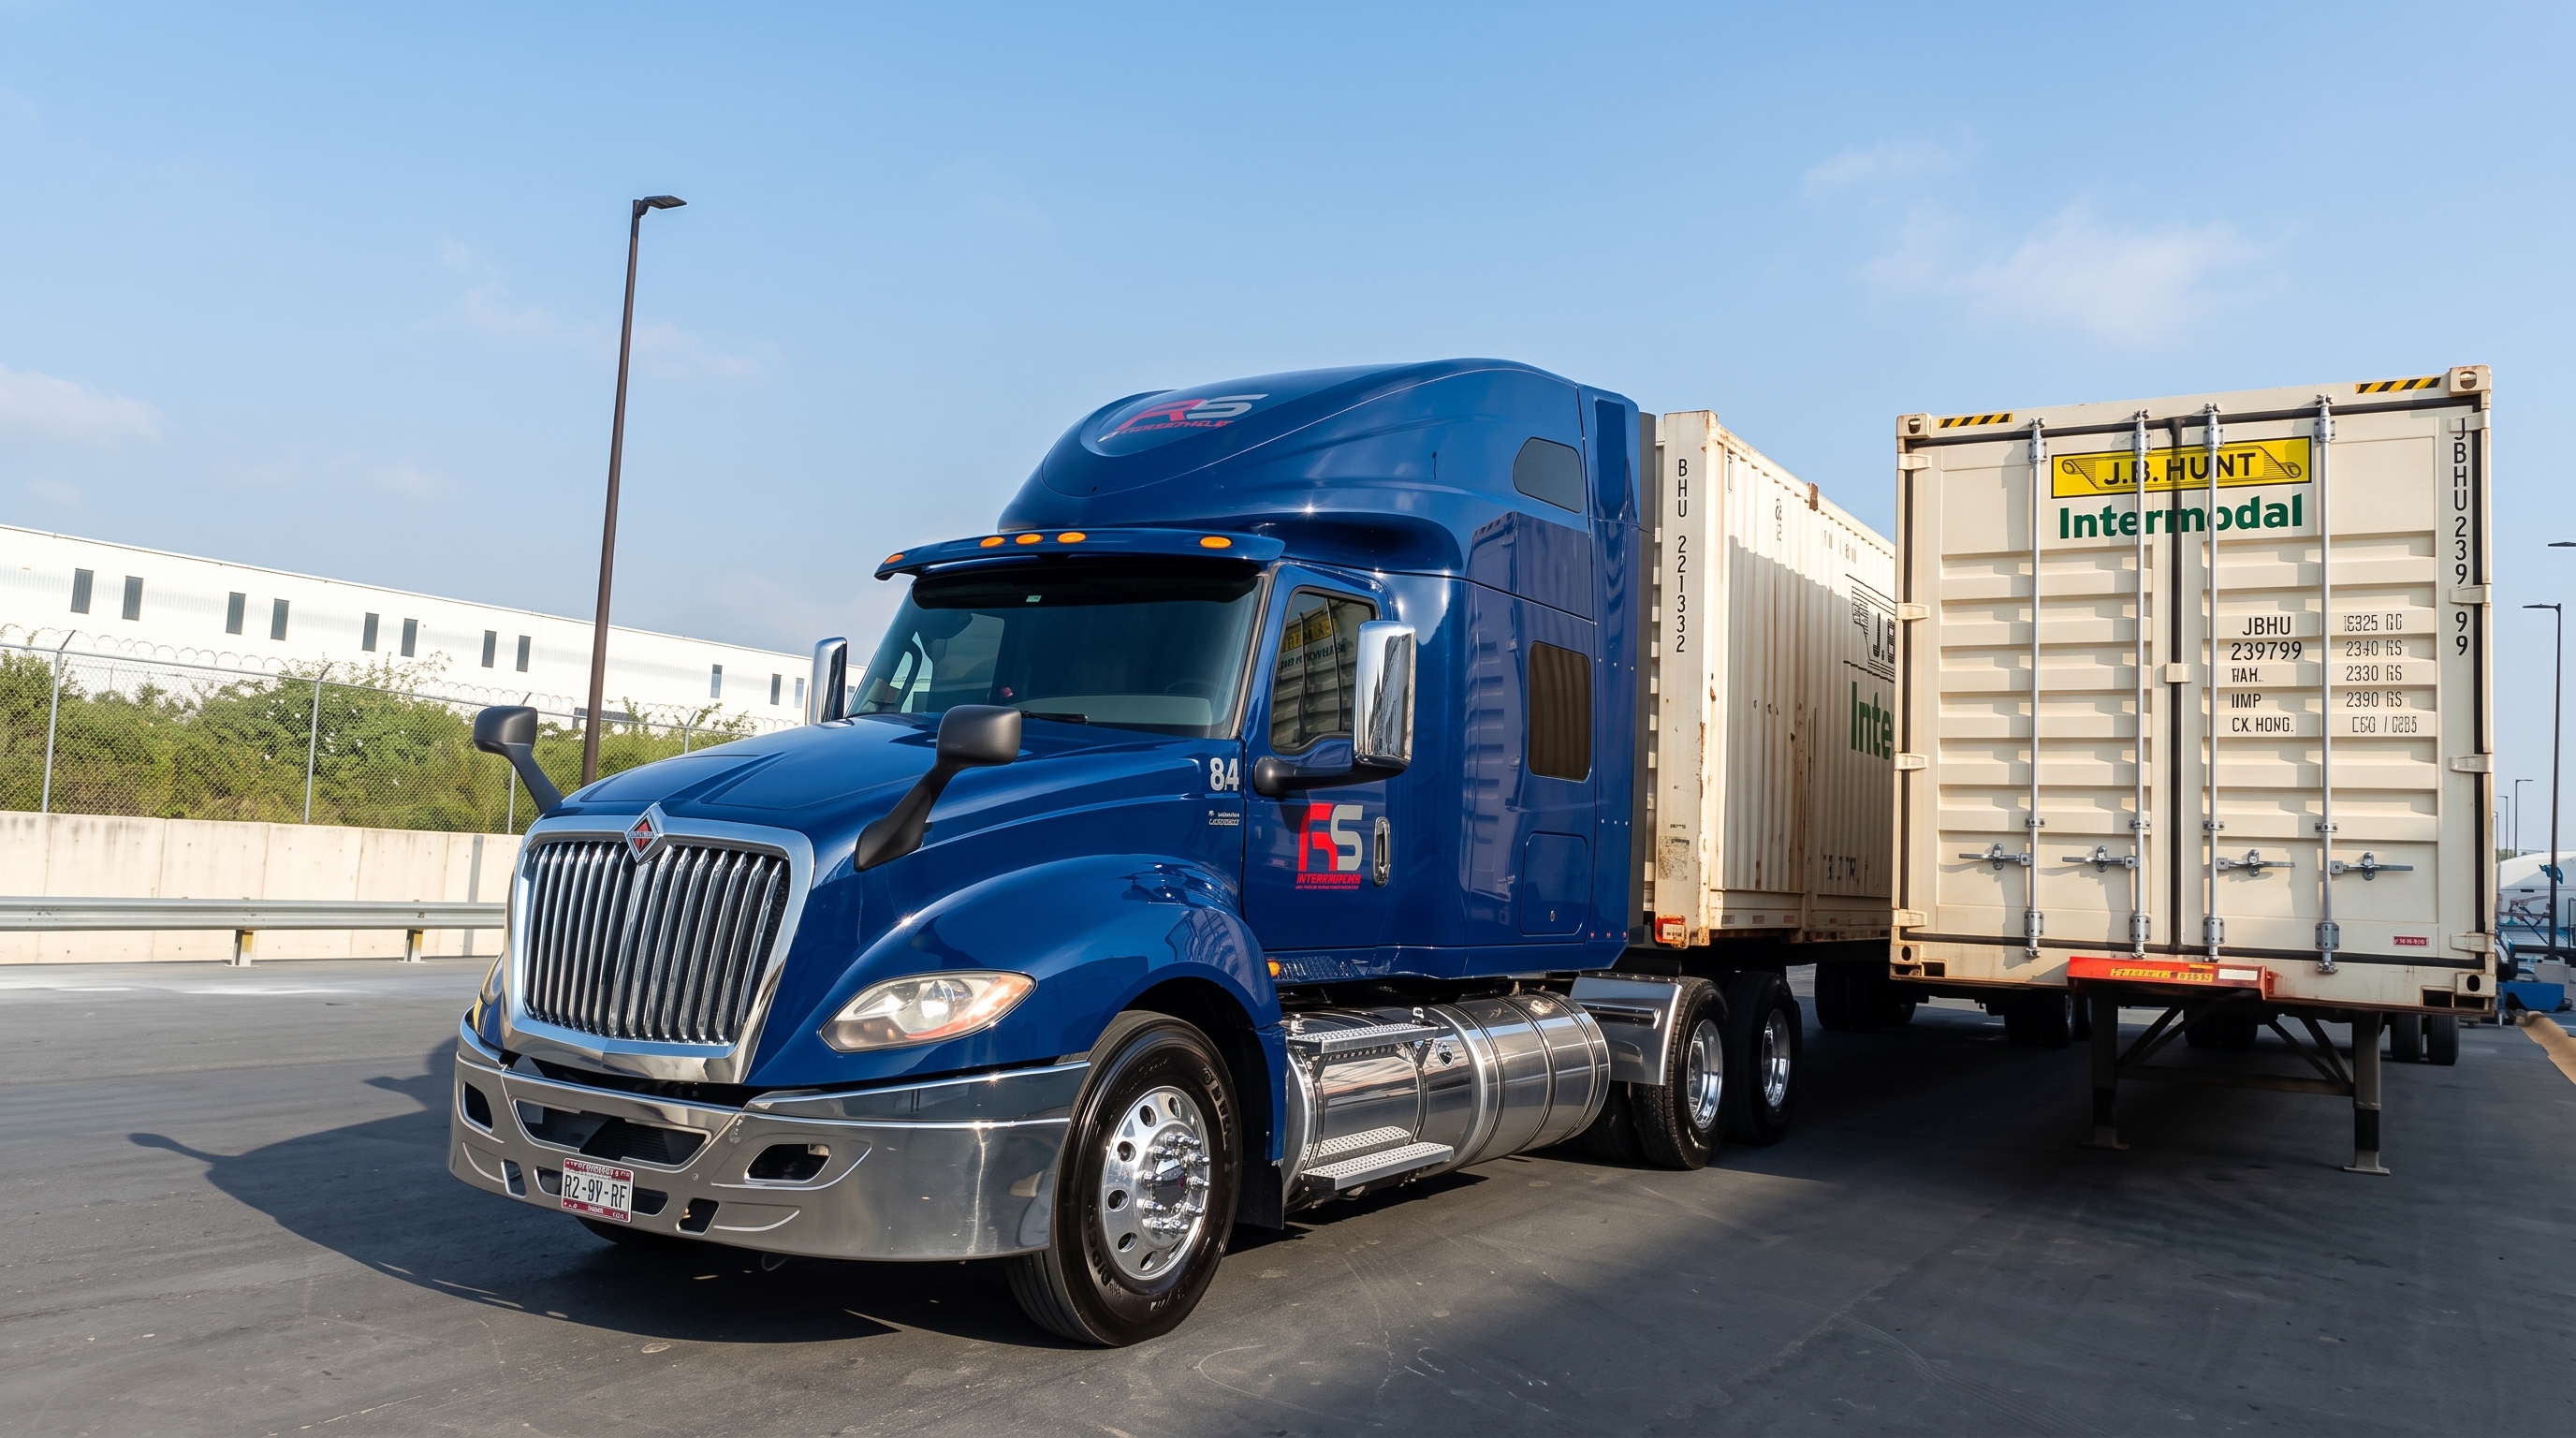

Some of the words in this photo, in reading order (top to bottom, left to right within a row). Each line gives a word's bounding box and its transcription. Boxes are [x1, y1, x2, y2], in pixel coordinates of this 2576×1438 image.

[2165, 452, 2256, 482] HUNT
[1677, 459, 1688, 518] BHU
[2059, 493, 2303, 539] Intermodal
[1676, 536, 1687, 653] 221332
[2242, 616, 2291, 636] JBHU
[2231, 640, 2303, 661] 239799
[2346, 665, 2378, 682] 2330
[2346, 691, 2378, 708] 2390
[1851, 681, 1895, 761] Inte
[1209, 757, 1240, 791] 84
